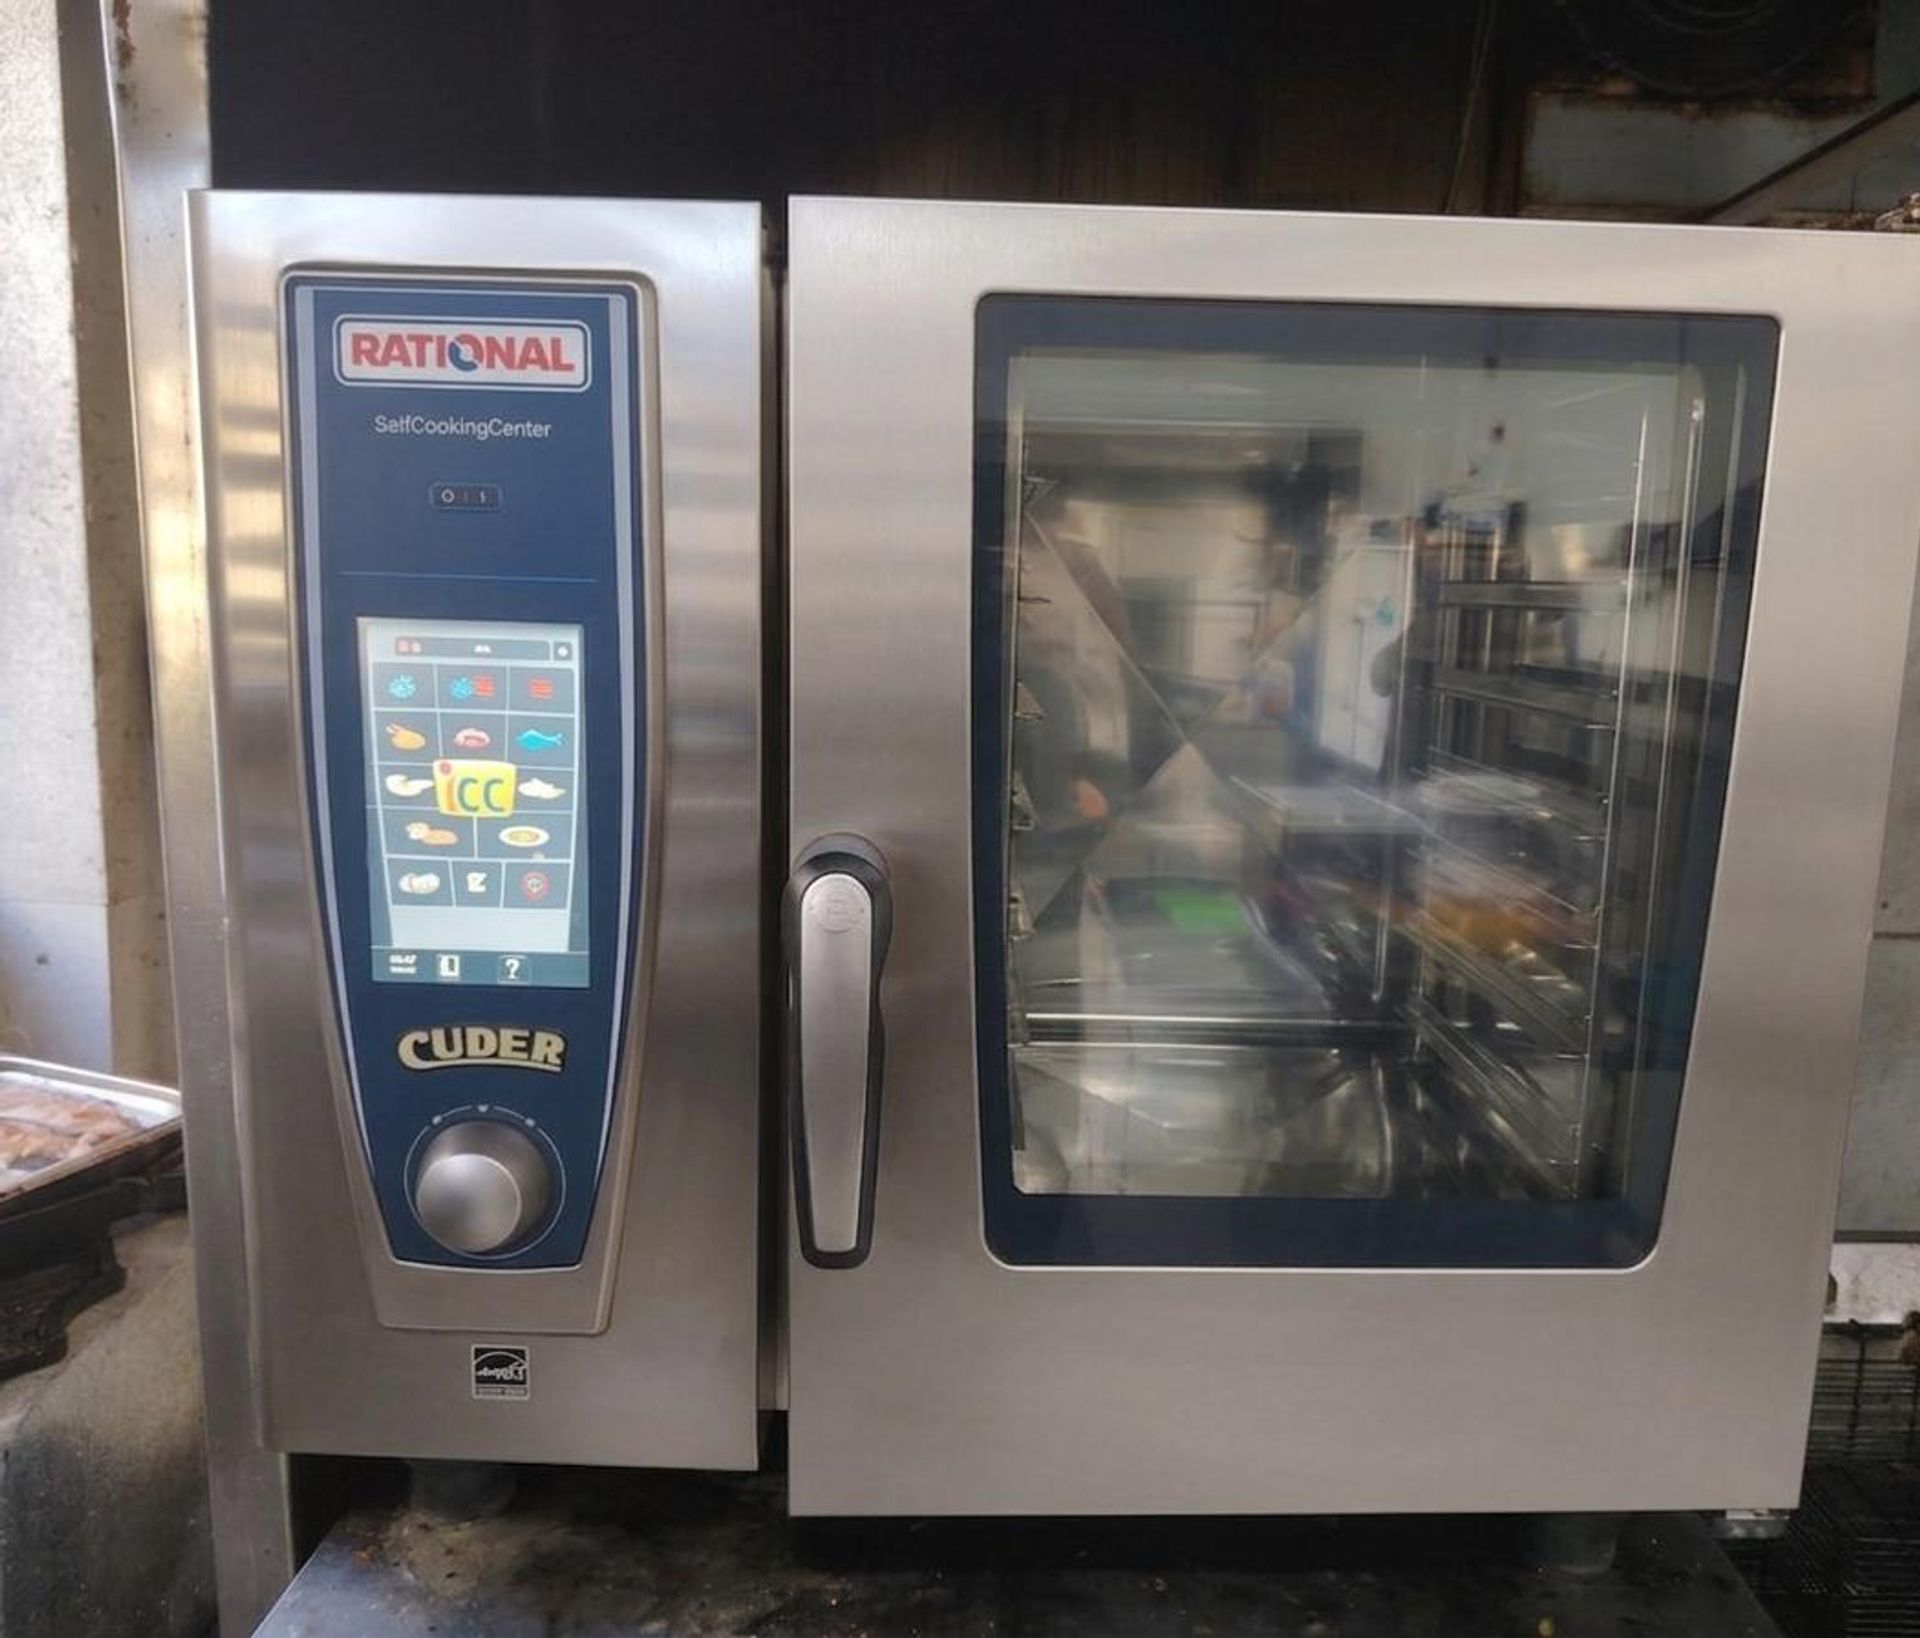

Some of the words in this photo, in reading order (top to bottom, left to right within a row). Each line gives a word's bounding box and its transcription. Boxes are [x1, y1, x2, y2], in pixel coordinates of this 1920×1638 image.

[351, 332, 574, 372] RATIONAL
[374, 415, 551, 440] SelfCookingCenter
[398, 1026, 566, 1072] CUDER
